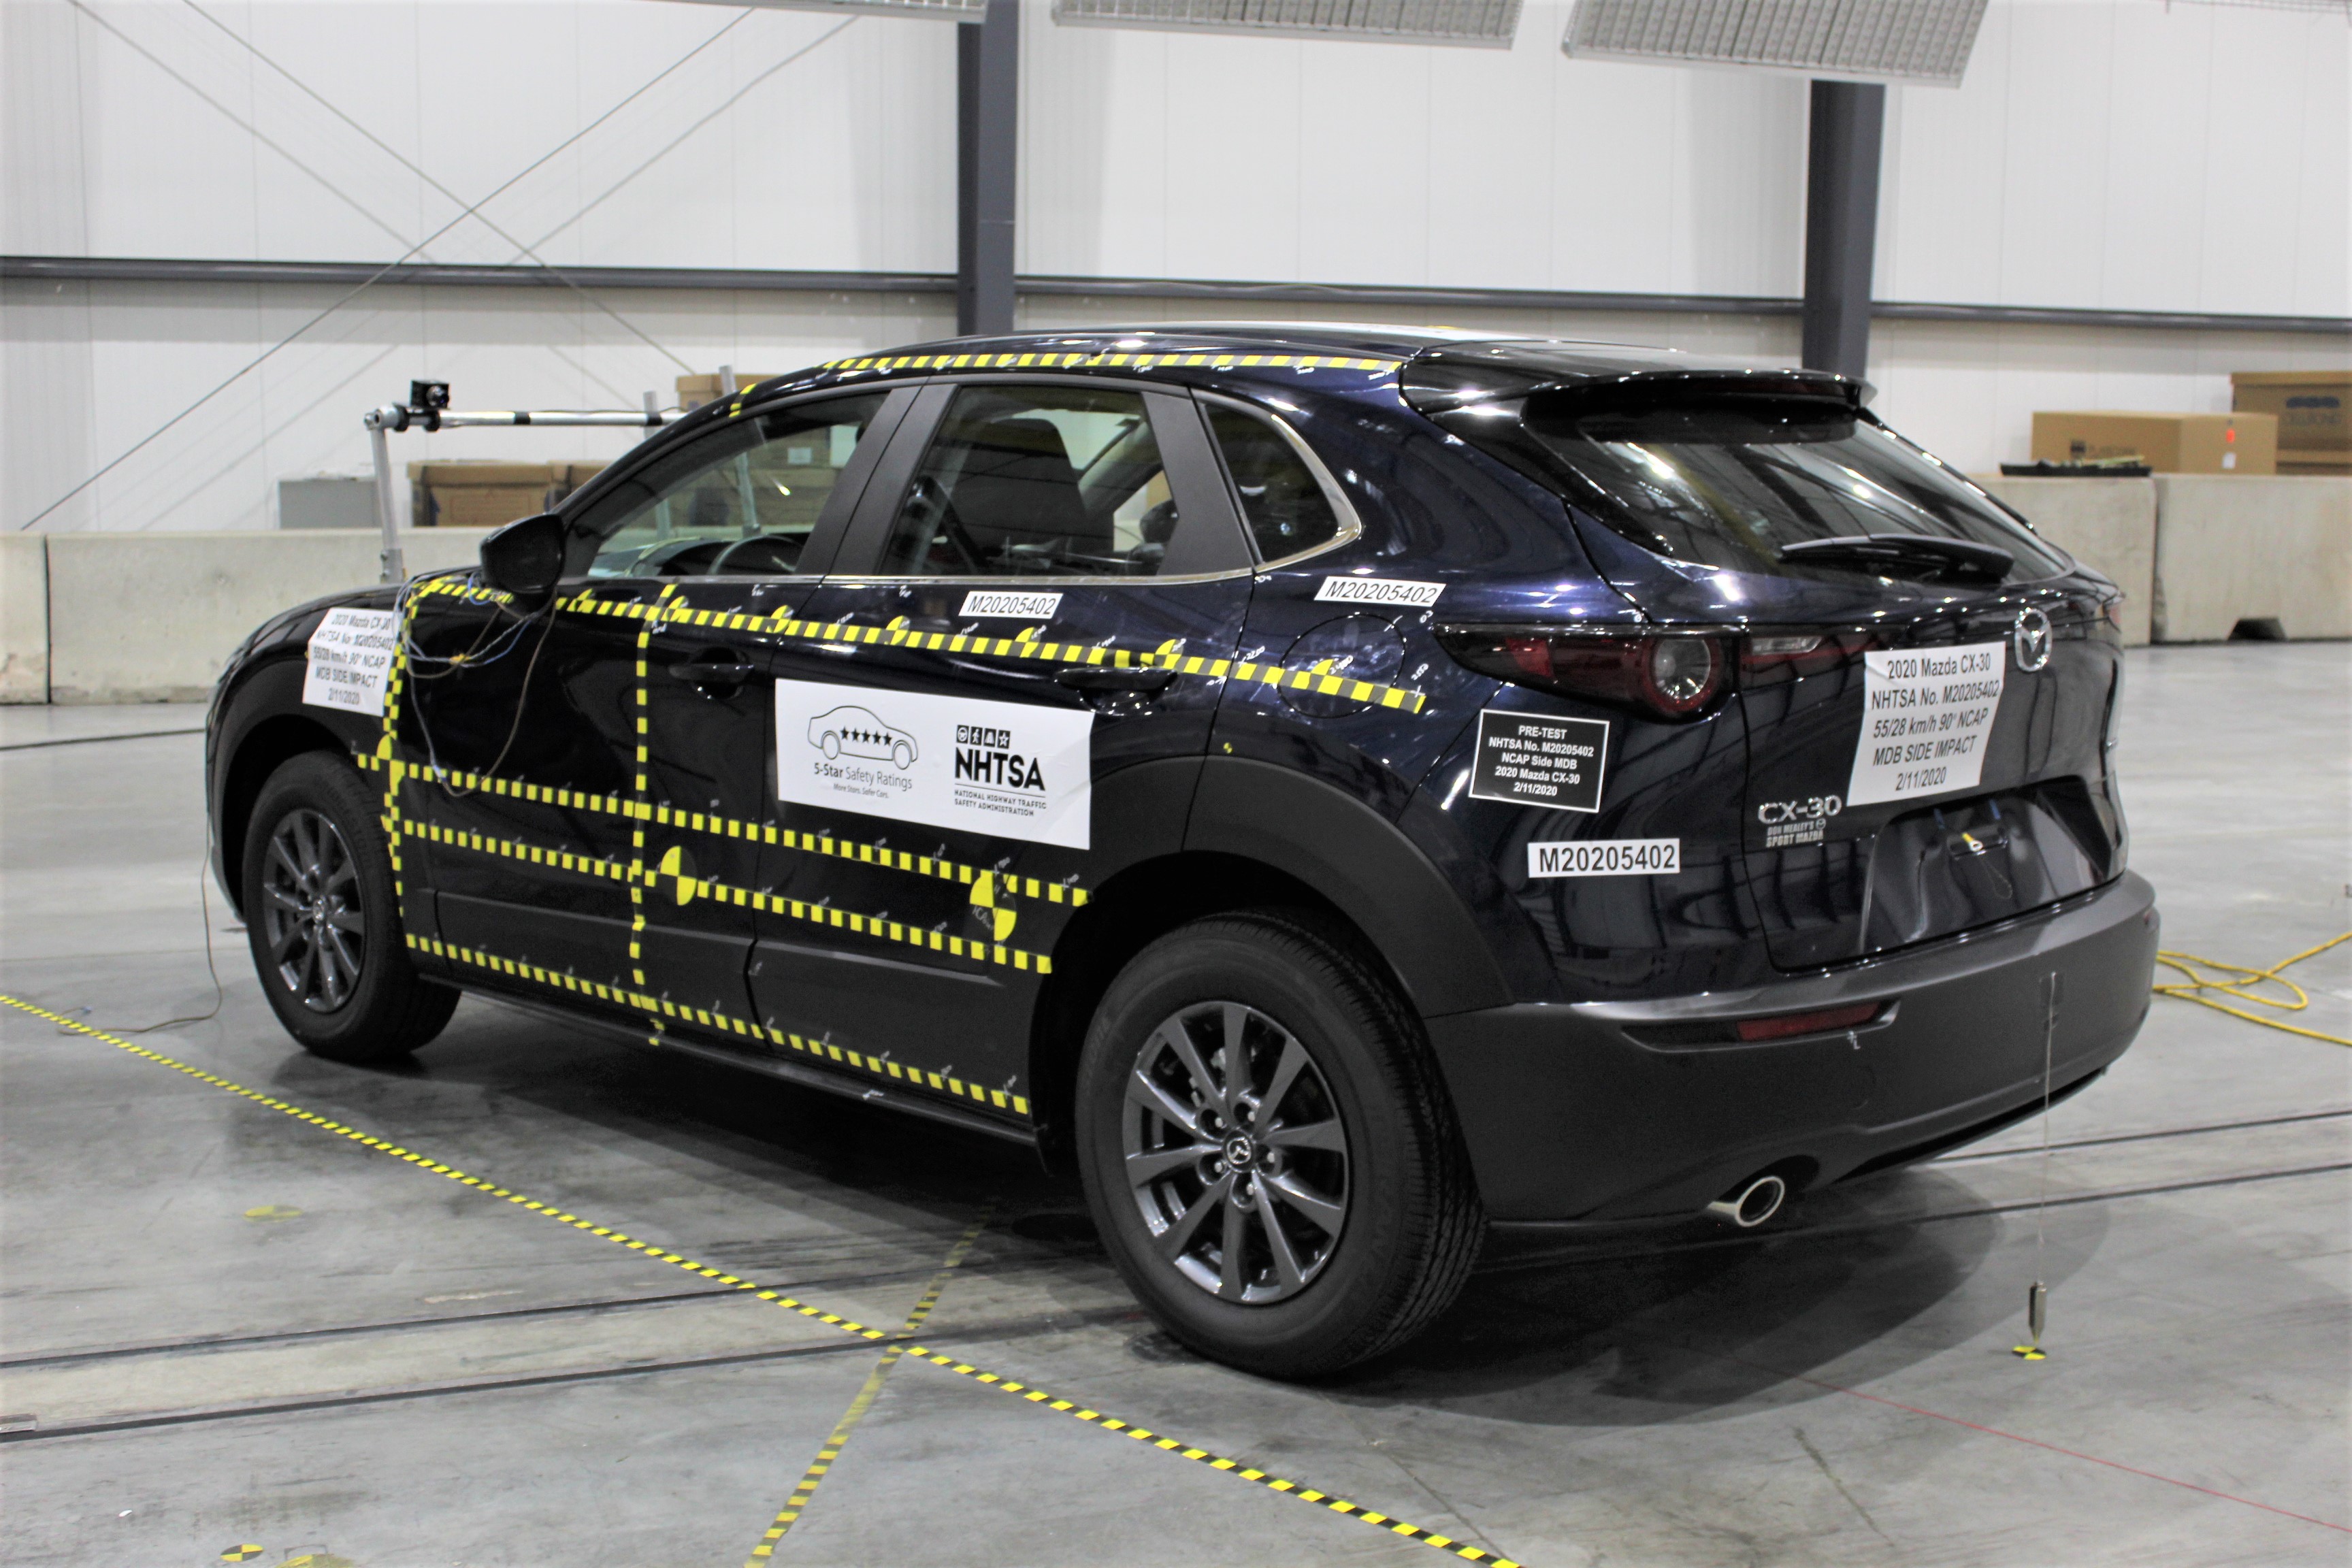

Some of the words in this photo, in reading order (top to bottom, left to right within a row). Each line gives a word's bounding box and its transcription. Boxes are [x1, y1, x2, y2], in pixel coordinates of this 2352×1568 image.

[1325, 581, 1438, 604] M20205402
[967, 595, 1056, 615] M20205402
[331, 615, 348, 624] 2020
[348, 615, 368, 627] Mazda
[316, 630, 340, 642] NHTSA
[353, 634, 393, 651] M20205402
[314, 647, 329, 659] 55/28
[363, 656, 386, 668] NCAP
[1887, 659, 1917, 679] 2020
[1921, 656, 1957, 677] Mazda
[1961, 653, 1991, 673] CX-30
[315, 667, 331, 680] MDB
[332, 669, 347, 682] SIDE
[349, 672, 378, 688] IMPACT
[328, 688, 359, 705] 2/11/2020
[1872, 689, 1916, 710] NHTSA
[1920, 687, 1938, 706] No.
[1942, 679, 2000, 704] M20205402
[1518, 725, 1567, 740] PRE-TEST
[1874, 717, 1907, 738] 55/28
[1908, 715, 1937, 735] km/h
[1957, 707, 1989, 729] NCAP
[1488, 736, 1522, 750] NHTSA
[1524, 740, 1540, 752] No.
[1541, 742, 1595, 757] M20205402
[1873, 746, 1903, 766] MDB
[1905, 742, 1934, 763] SIDE
[1934, 735, 1978, 758] IMPACT
[955, 747, 1045, 791] NHTSA
[1501, 752, 1530, 765] NCAP
[1531, 755, 1552, 767] Side
[1554, 757, 1578, 770] MDB
[814, 762, 843, 778] 5-Star
[845, 766, 874, 786] Safety
[877, 771, 912, 791] Ratings
[1494, 766, 1518, 778] 2020
[1519, 768, 1550, 782] Mazda
[1551, 772, 1580, 785] CX-30
[1895, 766, 1947, 792] 2/11/2020
[833, 783, 846, 791] More
[862, 787, 875, 796] Safer
[876, 789, 889, 798] Cars.
[955, 789, 985, 800] NATIONAL
[987, 795, 1016, 804] HIGHWAY
[1018, 799, 1047, 809] TRAFFIC
[1513, 782, 1558, 797] 2/11/2020
[955, 798, 977, 808] SAFETY
[978, 803, 1034, 816] ADMINISTRATION
[1758, 795, 1842, 824] CX-30
[1766, 834, 1795, 848] SPORT
[1795, 829, 1824, 844] MAZDA
[1539, 844, 1676, 873] M20205402
